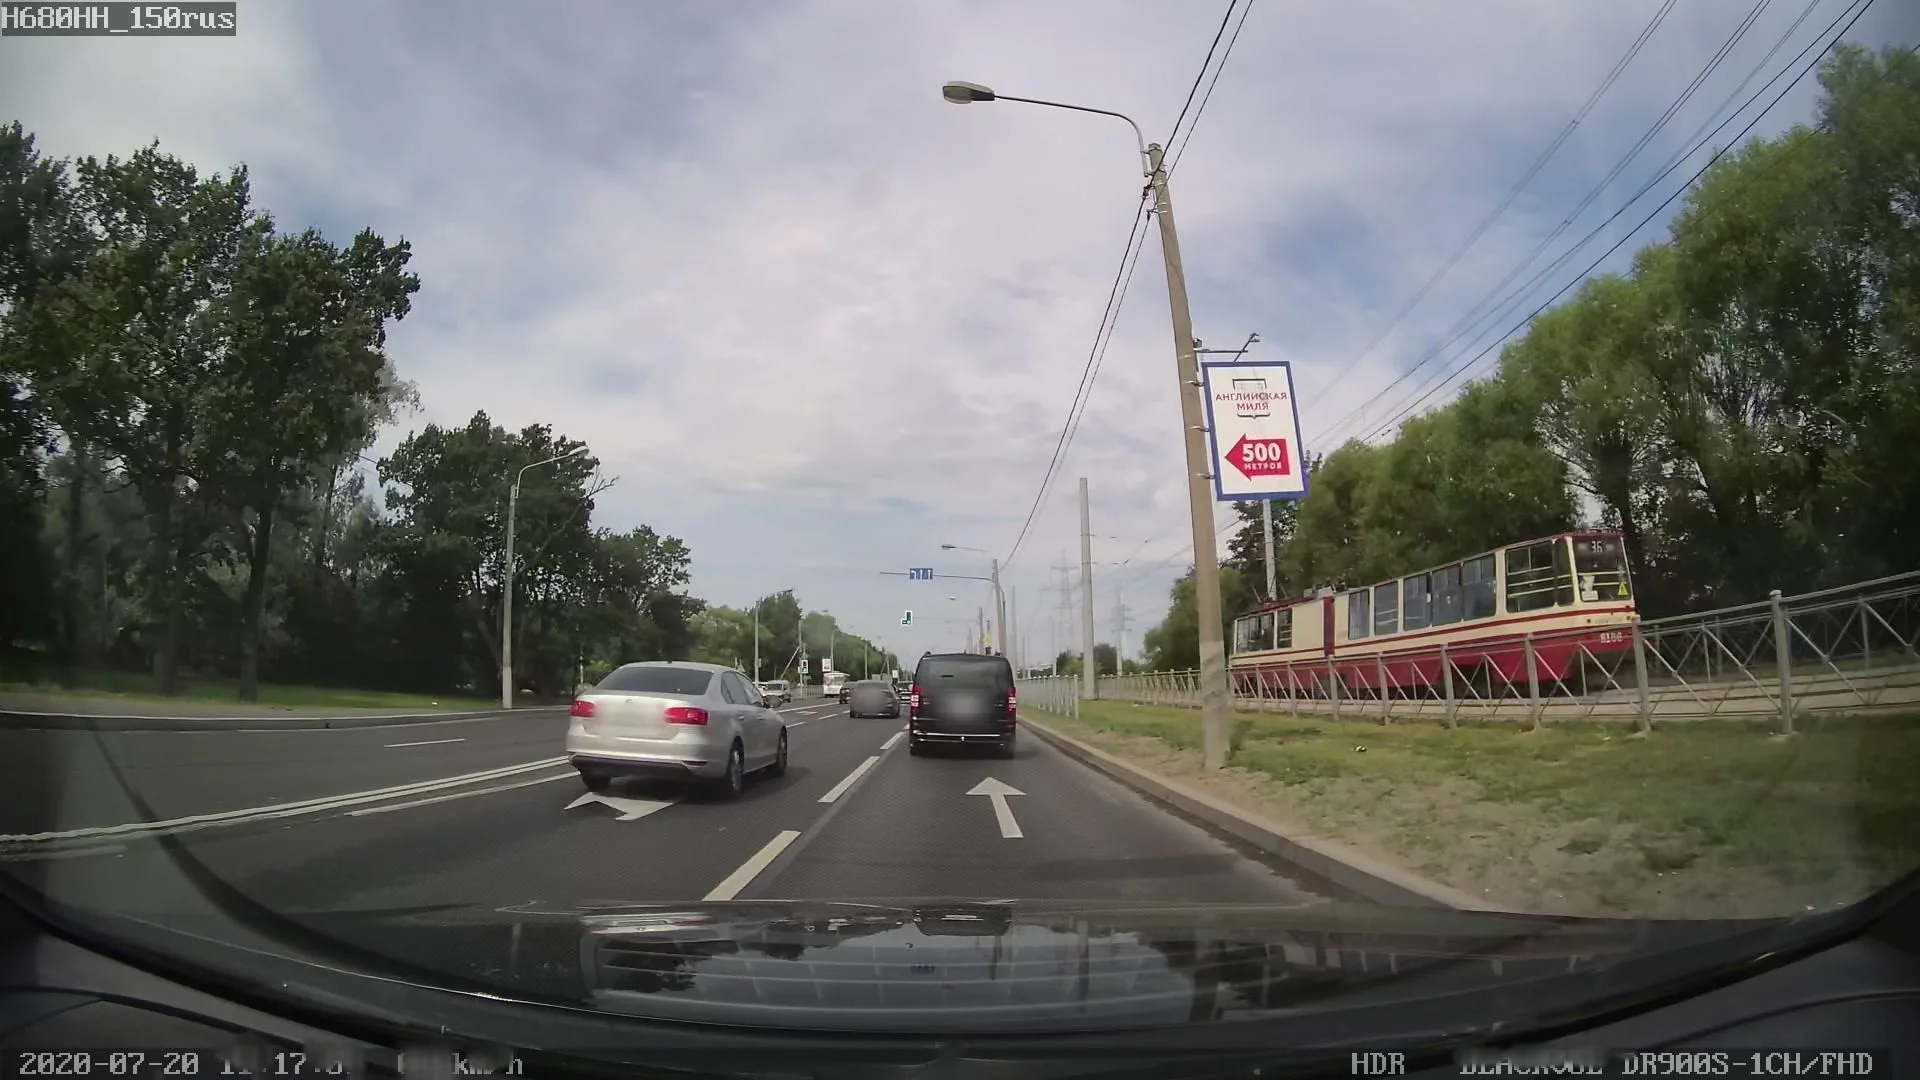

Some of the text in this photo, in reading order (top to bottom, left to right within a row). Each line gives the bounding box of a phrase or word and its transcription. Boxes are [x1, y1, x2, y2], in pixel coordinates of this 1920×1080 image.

[1236, 402, 1270, 411] МИЛЯ
[1242, 443, 1281, 462] 500
[1243, 461, 1283, 470] МЕТРОВ
[1591, 540, 1603, 553] 36
